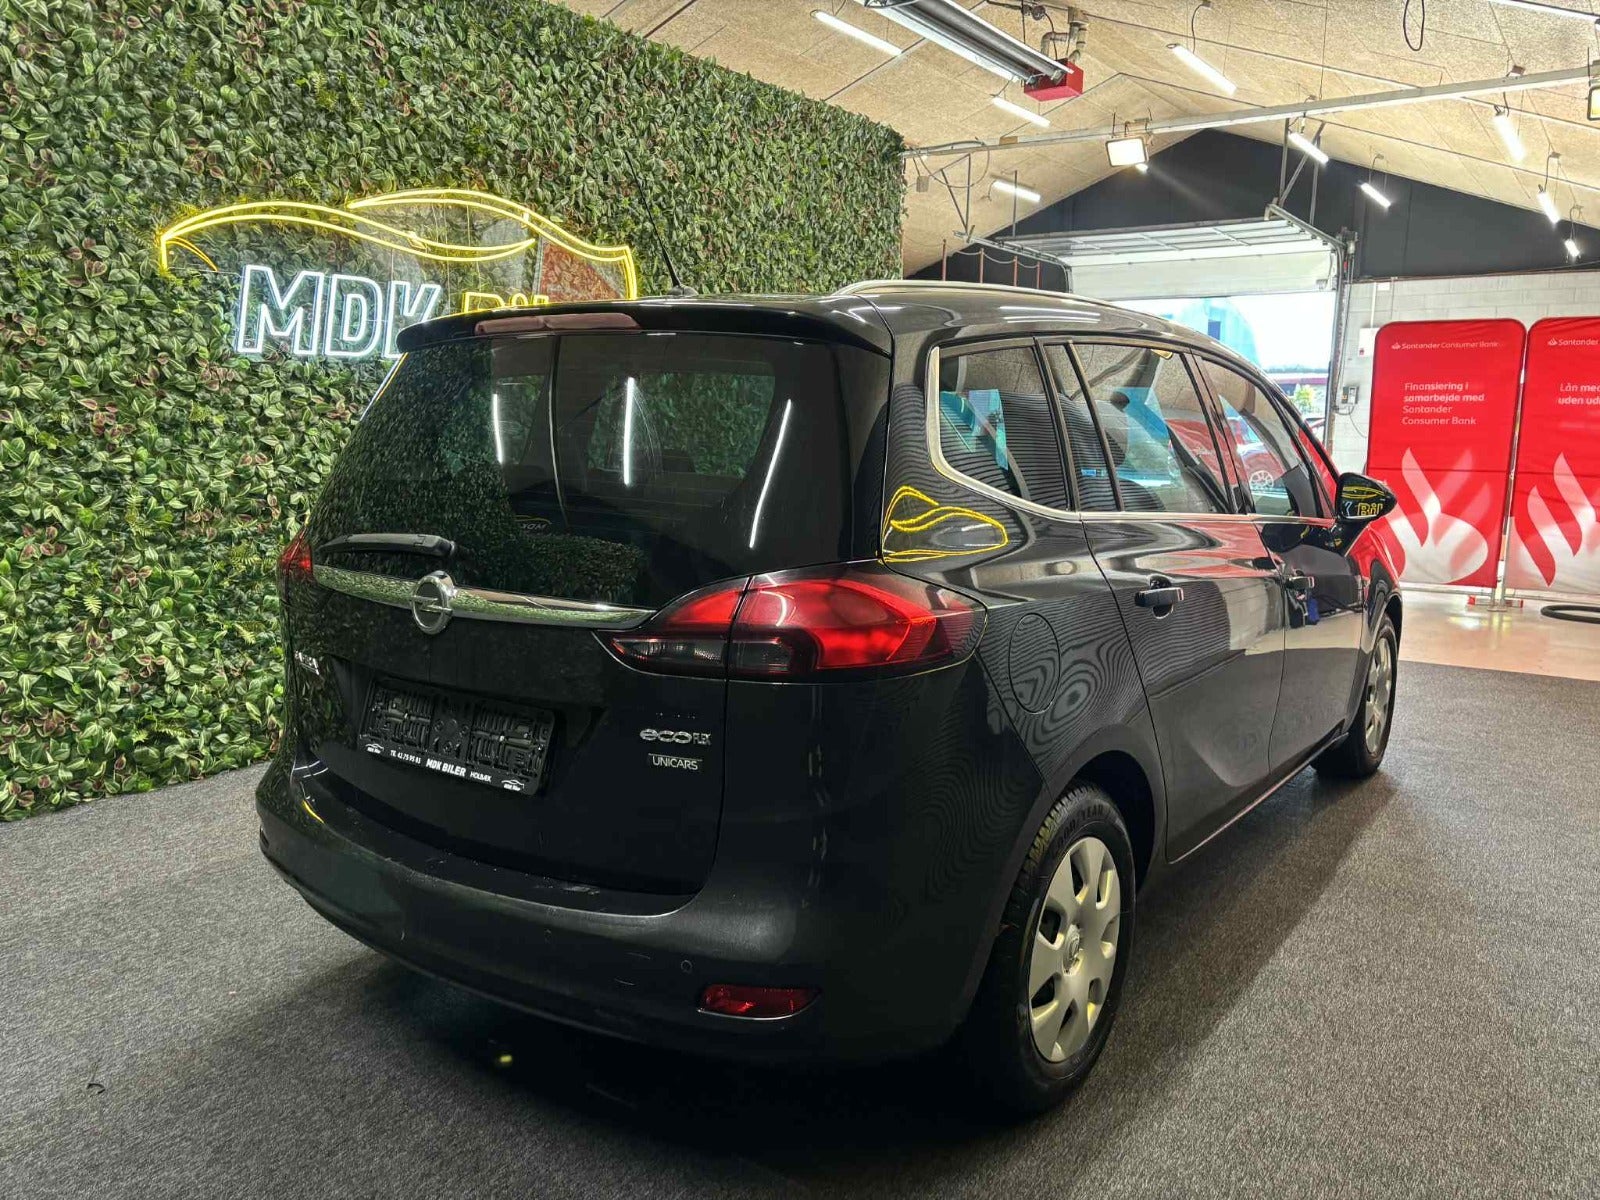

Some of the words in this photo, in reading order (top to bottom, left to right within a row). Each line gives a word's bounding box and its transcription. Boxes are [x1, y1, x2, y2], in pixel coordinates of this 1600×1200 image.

[237, 264, 442, 359] MDK
[1401, 342, 1440, 350] Santander
[1441, 341, 1478, 349] Consumer
[1405, 382, 1464, 392] Finansiering
[1560, 383, 1579, 392] Lån
[1404, 394, 1461, 403] samarbejde
[1462, 394, 1485, 402] med
[1558, 396, 1584, 404] uden
[1403, 405, 1453, 414] Santander
[1402, 417, 1450, 425] Consumer
[1451, 416, 1477, 425] Bank
[425, 758, 442, 771] MDK
[442, 762, 467, 777] BILER
[652, 755, 698, 771] UNICARS
